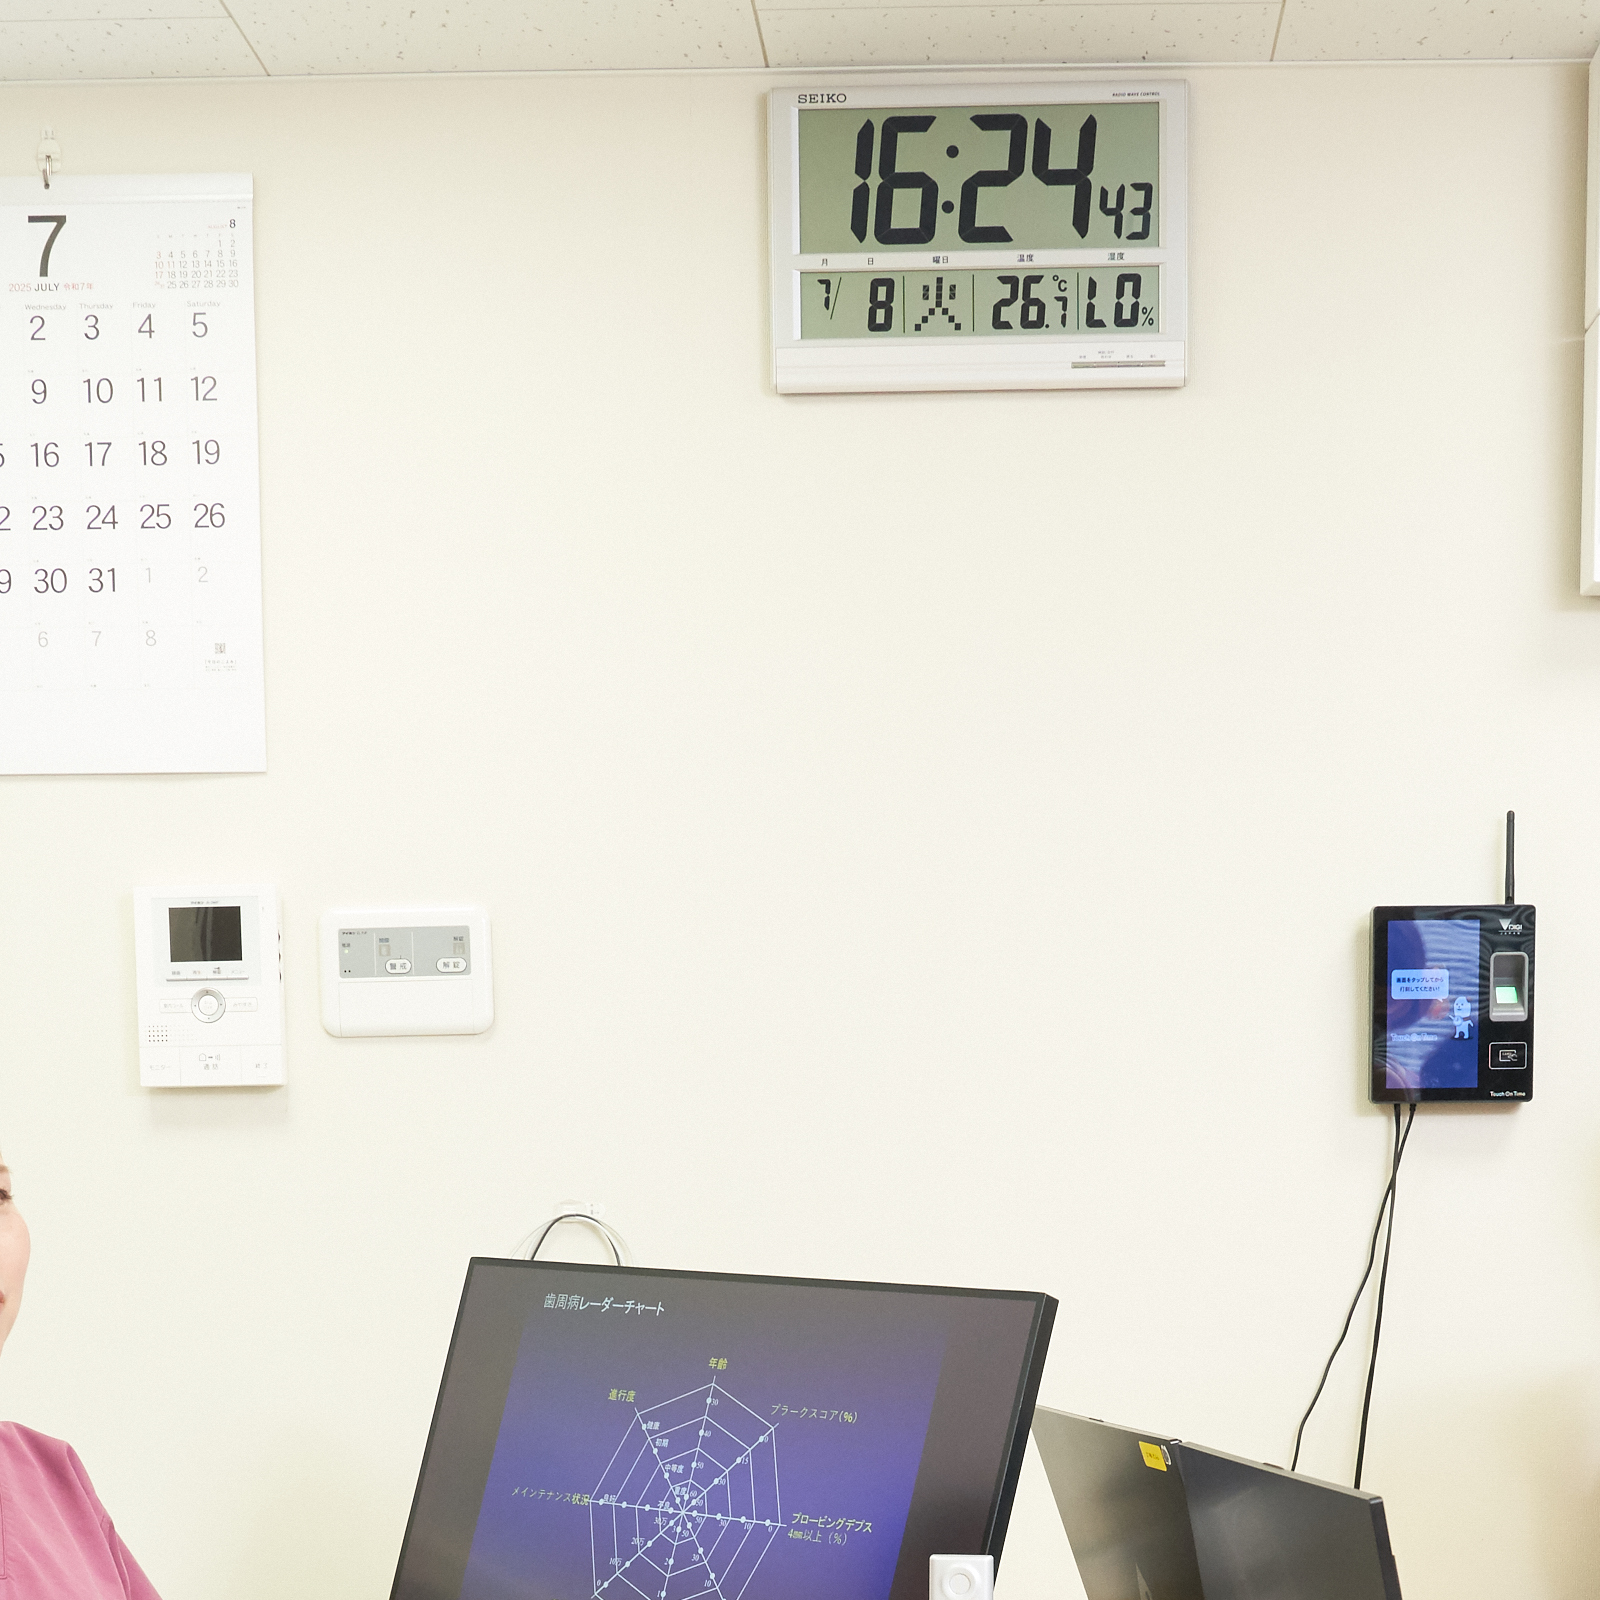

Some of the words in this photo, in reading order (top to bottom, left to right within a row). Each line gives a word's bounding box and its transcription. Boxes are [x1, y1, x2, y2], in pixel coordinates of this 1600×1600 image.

[798, 93, 847, 104] SEIKO
[851, 114, 1097, 245] 16:24
[1099, 183, 1152, 240] 43
[229, 219, 236, 228] 8
[28, 215, 66, 277] 7
[821, 258, 828, 266] 月
[868, 257, 874, 265] 日
[933, 255, 949, 264] 曜日
[1017, 253, 1034, 263] 温度
[1108, 252, 1125, 261] 湿度
[9, 283, 32, 292] 2025
[34, 283, 60, 292] JULY
[63, 282, 95, 291] 令和7年
[24, 303, 67, 312] Wednesday
[79, 302, 114, 310] Thursday
[133, 301, 157, 310] Friday
[186, 300, 221, 308] Saturday
[867, 278, 894, 331] 8
[915, 277, 961, 331] 火
[30, 316, 45, 340] 2
[84, 315, 99, 340] 3
[138, 314, 155, 338] 4
[193, 312, 208, 338] 5
[32, 379, 47, 404] 9
[83, 378, 113, 403] 10
[137, 377, 162, 402] 11
[191, 376, 217, 401] 12
[31, 442, 59, 467] 16
[85, 442, 112, 466] 17
[139, 441, 167, 466] 18
[192, 440, 220, 464] 19
[32, 506, 64, 530] 23
[86, 505, 118, 529] 24
[140, 504, 171, 529] 25
[194, 503, 225, 528] 26
[34, 568, 67, 593] 30
[89, 568, 115, 593] 31
[144, 567, 152, 584] 1
[198, 566, 208, 583] 2
[38, 631, 48, 648] 6
[92, 631, 101, 646] 7
[146, 630, 157, 646] 8
[544, 1294, 665, 1316] 歯周病レーダーチャート
[708, 1357, 728, 1370] 年齢
[608, 1388, 636, 1403] 進行度
[647, 1421, 660, 1430] 健康
[655, 1438, 669, 1447] 初期
[665, 1463, 684, 1474] 中等度
[741, 1457, 748, 1465] 15
[512, 1486, 590, 1505] メインテナンス状況
[692, 1554, 700, 1562] 30
